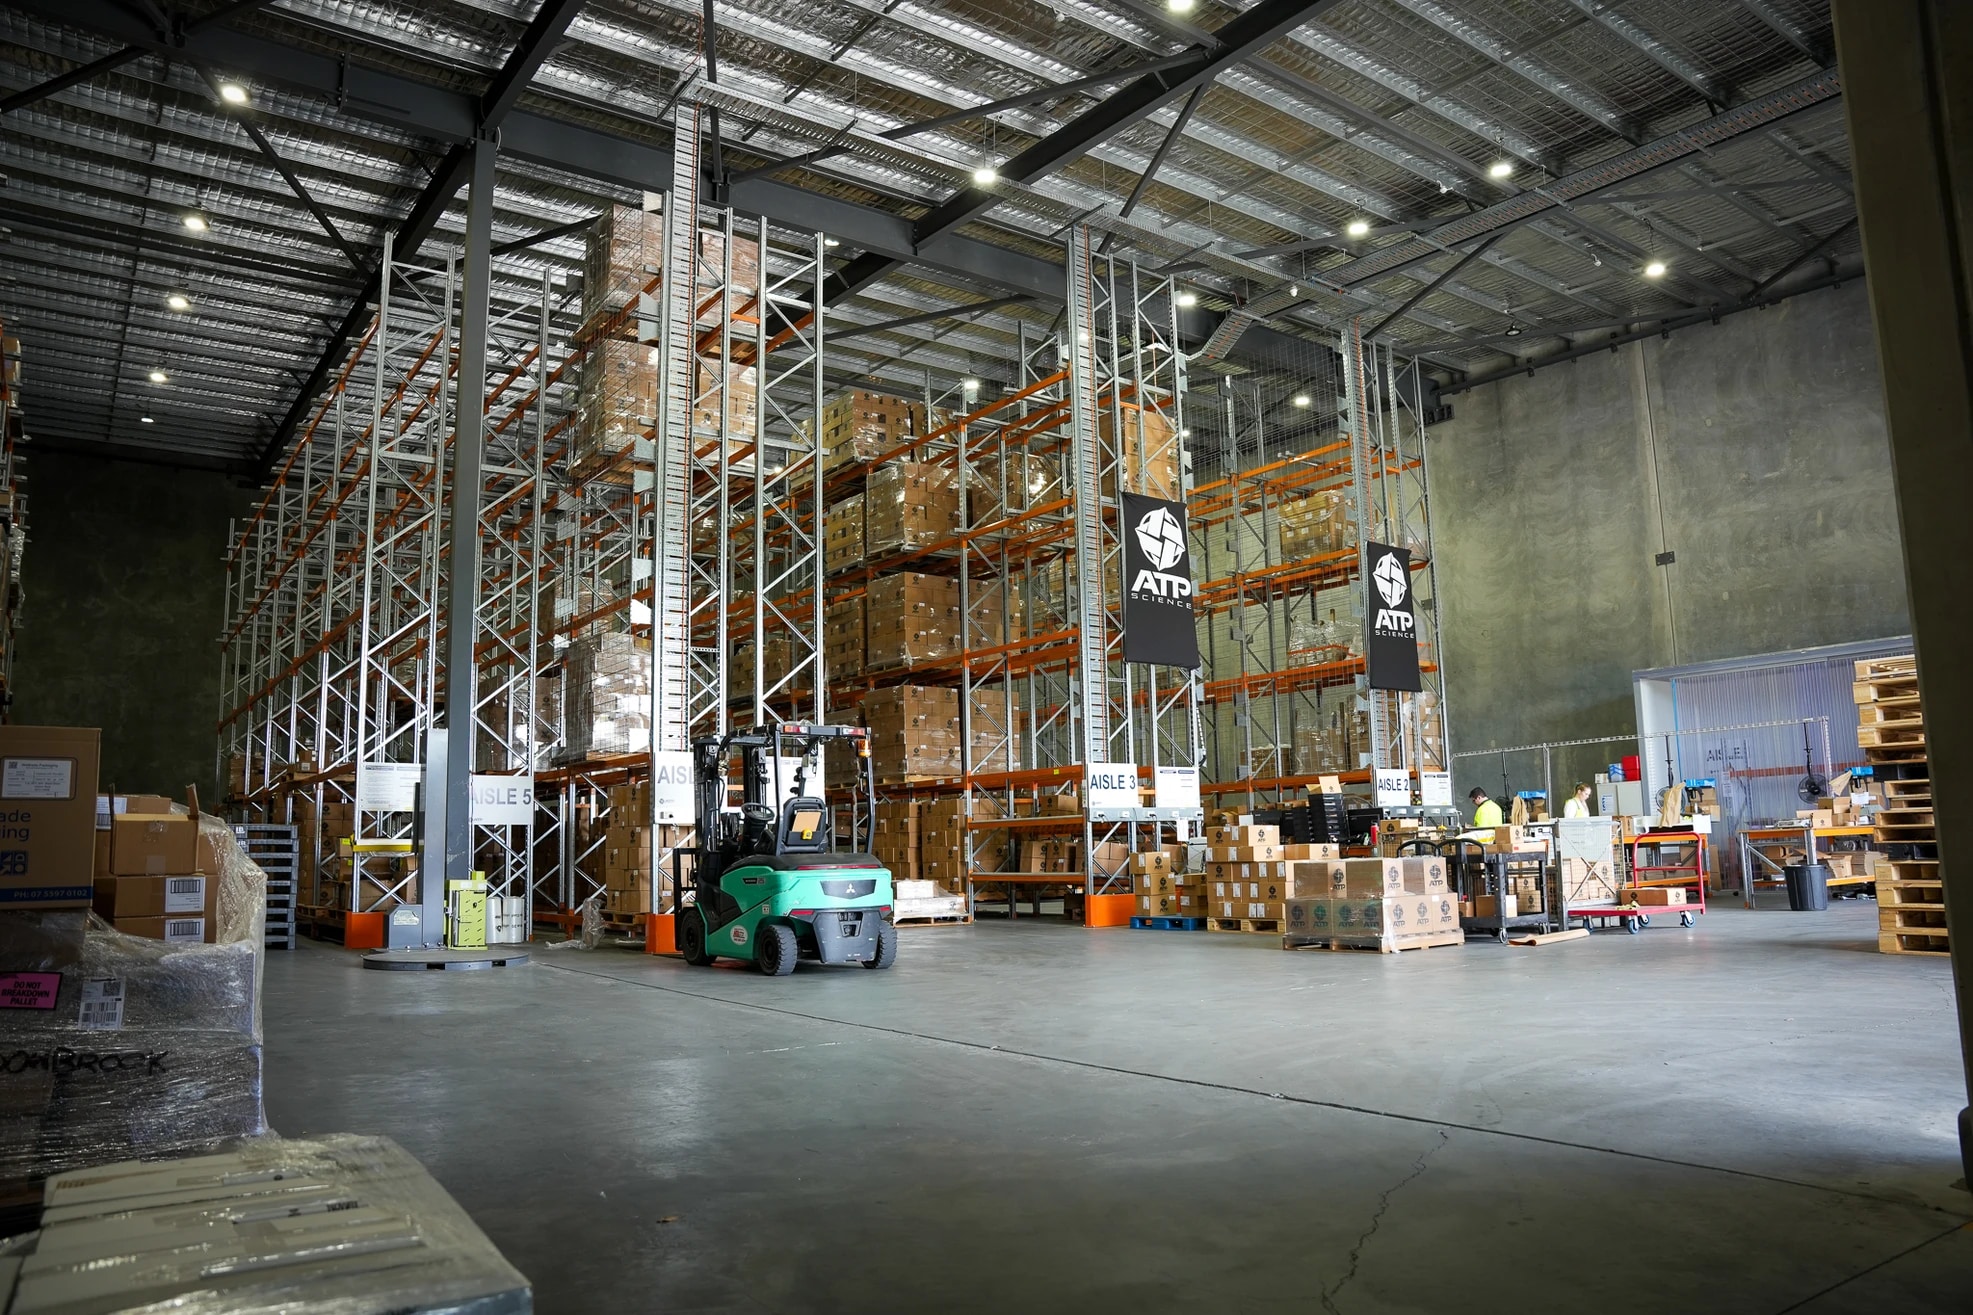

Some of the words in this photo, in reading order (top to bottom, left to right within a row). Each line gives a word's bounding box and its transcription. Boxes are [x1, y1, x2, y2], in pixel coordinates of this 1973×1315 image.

[1131, 569, 1192, 600] ATP
[1131, 592, 1192, 610] SCIENCE
[1374, 608, 1414, 631] ATP
[1374, 629, 1415, 639] SCIENCE
[1706, 747, 1744, 762] AIE
[657, 765, 695, 785] AISL
[1090, 774, 1126, 790] AISLE
[1129, 774, 1136, 790] 3
[1378, 778, 1402, 791] AISLE
[1403, 778, 1409, 791] 2
[522, 788, 532, 805] 5
[1333, 883, 1346, 891] ATP
[1387, 882, 1400, 890] ATP
[1429, 879, 1444, 888] ATP
[1393, 920, 1405, 928] ATP
[1417, 918, 1429, 926] ATP
[1440, 915, 1452, 923] ATP
[14, 981, 25, 989] DO
[26, 981, 42, 989] NOT
[1, 988, 50, 998] BREAKDOWN
[9, 997, 38, 1006] PALLET
